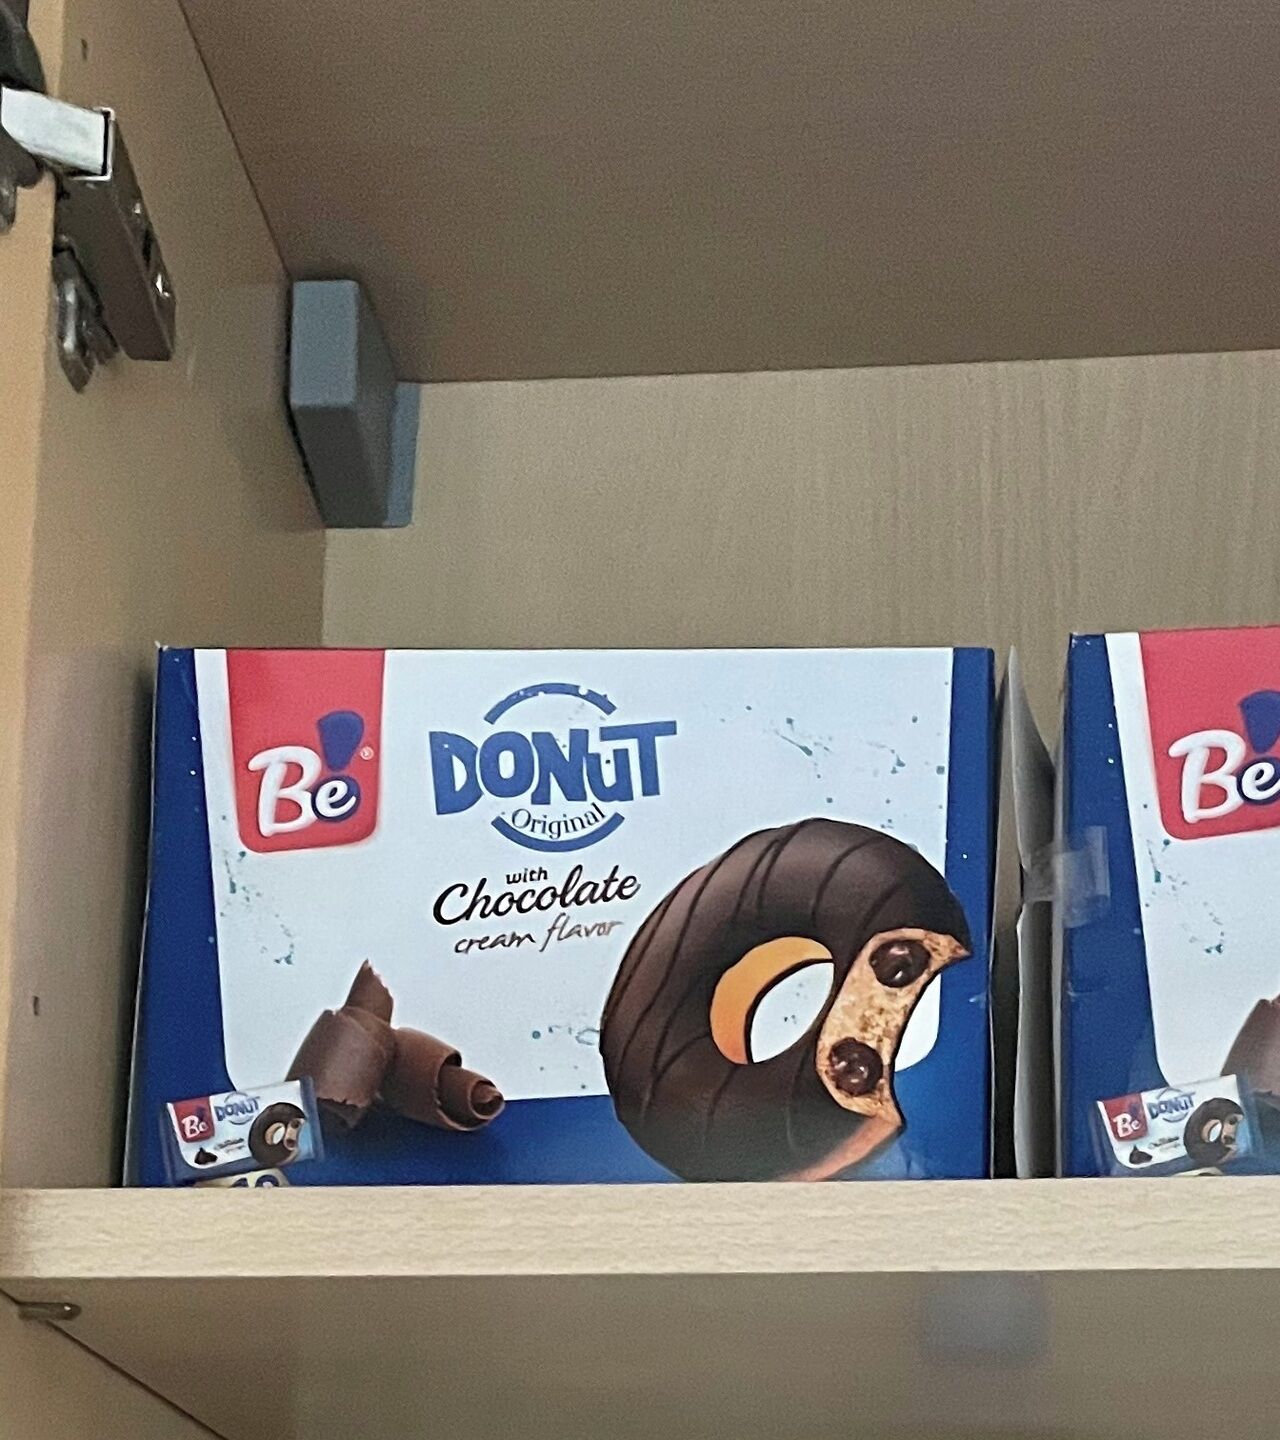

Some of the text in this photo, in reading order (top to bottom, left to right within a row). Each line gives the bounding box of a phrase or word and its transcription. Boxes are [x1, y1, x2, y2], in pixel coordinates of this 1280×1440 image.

[512, 803, 605, 839] Original
[433, 864, 641, 925] Chocolate
[506, 867, 548, 884] with
[455, 913, 623, 954] cream flavor
